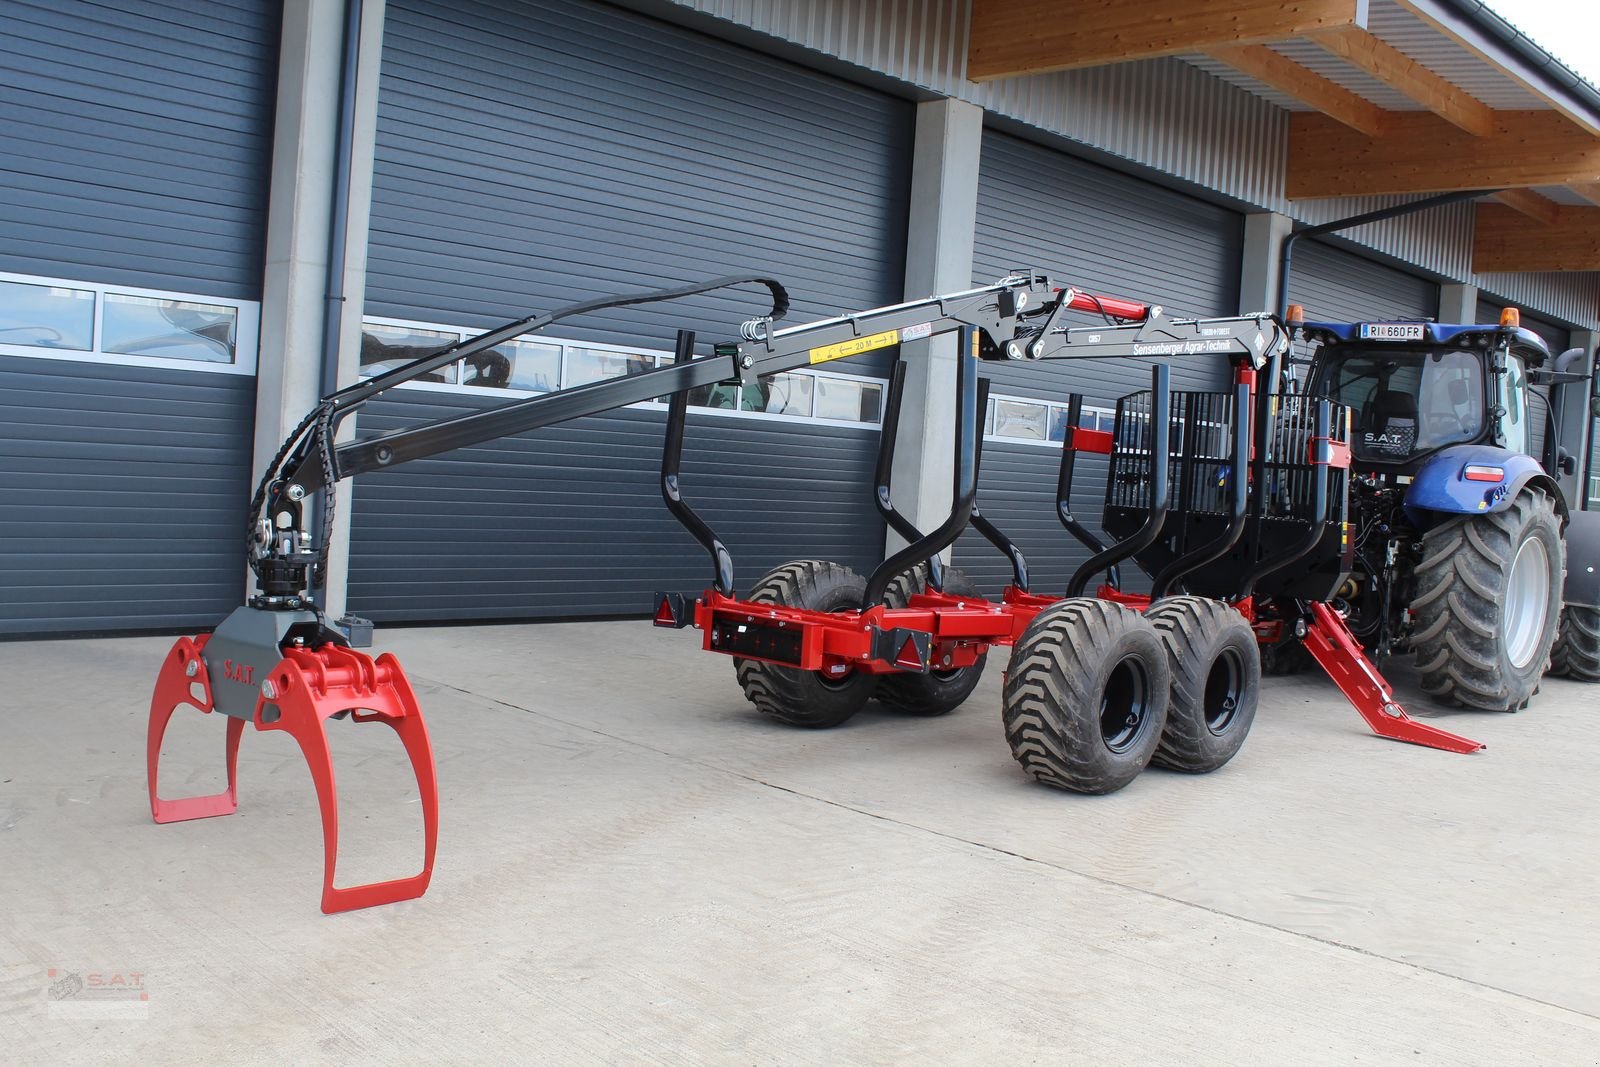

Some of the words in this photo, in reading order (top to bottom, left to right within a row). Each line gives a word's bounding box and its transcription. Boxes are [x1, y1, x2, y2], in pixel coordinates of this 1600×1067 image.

[1371, 327, 1380, 336] RI
[1388, 327, 1405, 337] 660
[1407, 327, 1419, 337] FR
[855, 341, 864, 351] 20
[865, 339, 873, 348] M
[1133, 342, 1183, 356] Sensenberger
[1184, 339, 1231, 355] Agrar-Technik
[1364, 432, 1401, 443] S.A.T.
[223, 659, 256, 686] S.A.T.
